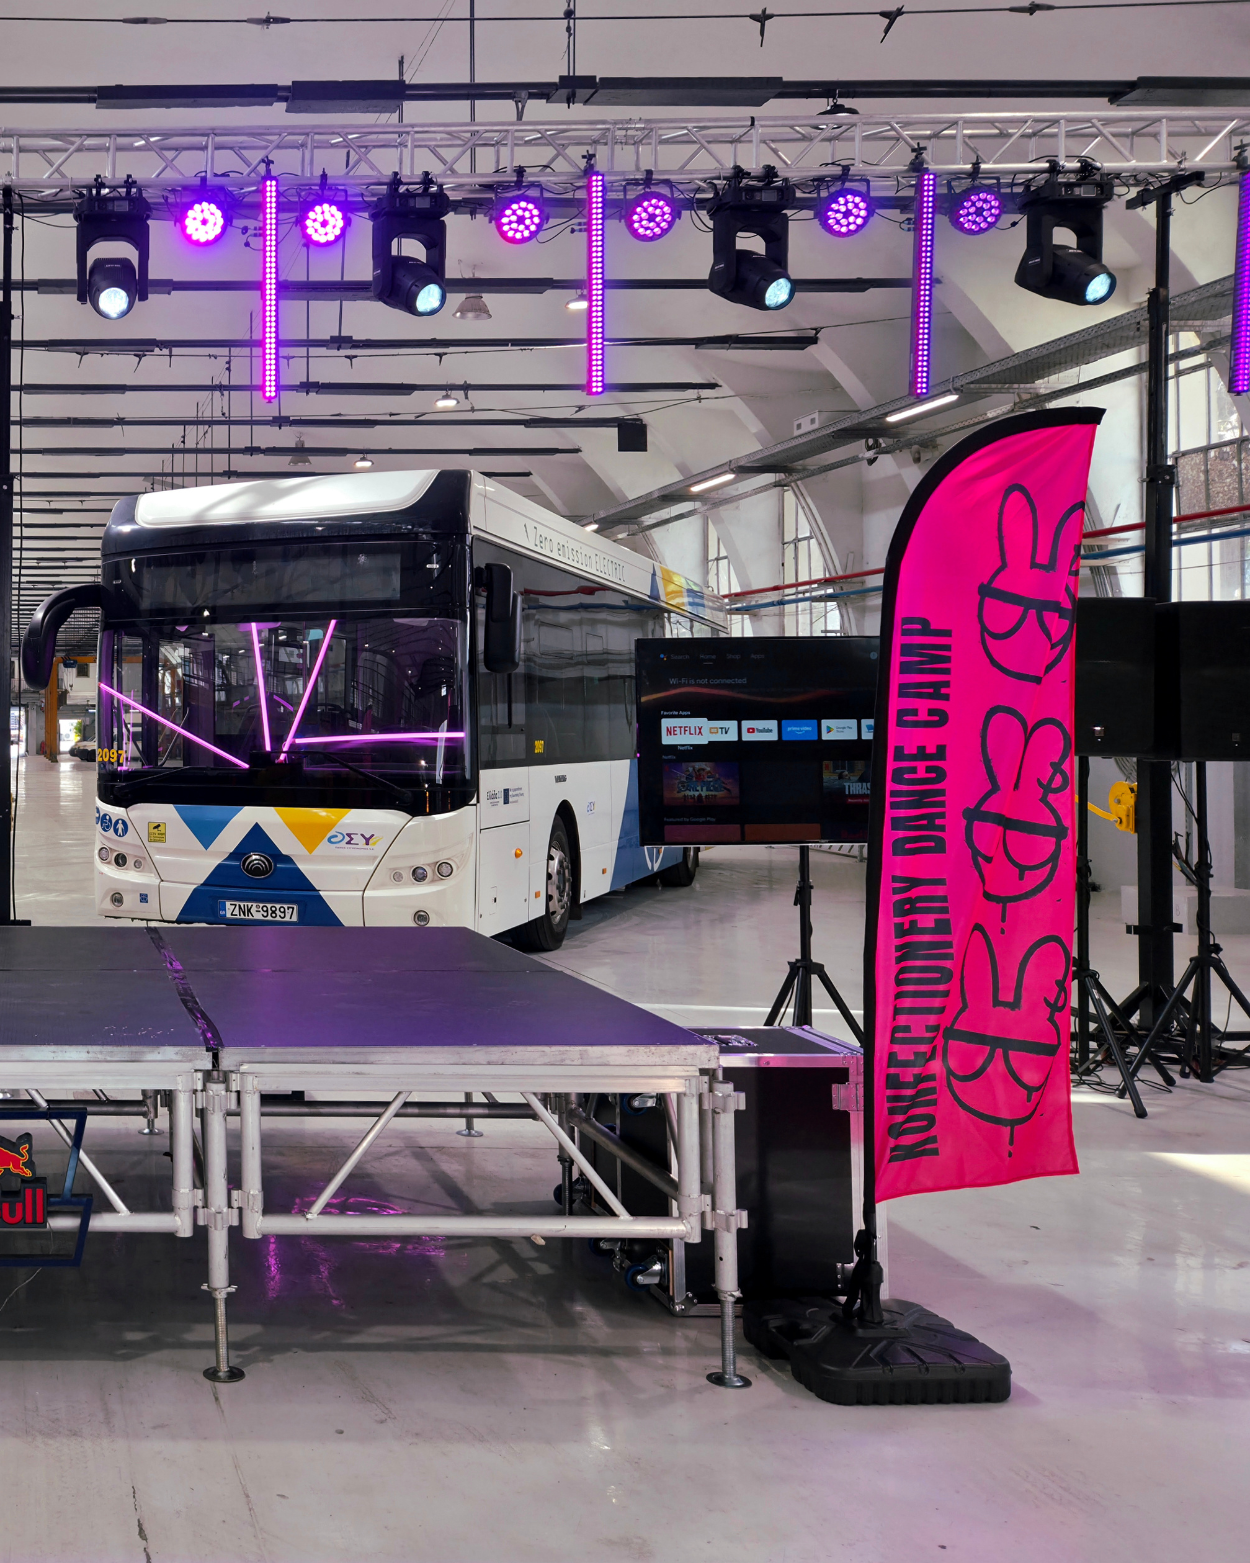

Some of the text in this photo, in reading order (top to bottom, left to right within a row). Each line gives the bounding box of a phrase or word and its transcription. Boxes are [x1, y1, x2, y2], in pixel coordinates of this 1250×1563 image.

[533, 525, 626, 582] Zero emission ELECTRIC
[726, 653, 742, 661] Shop
[669, 677, 747, 685] Wi-Fi is not connected
[666, 725, 704, 737] NETFLIX
[719, 726, 730, 735] TV
[97, 748, 125, 763] 2097
[843, 782, 871, 795] THRAS
[885, 616, 955, 1164] KONFECTIONERY DANCE CAMP
